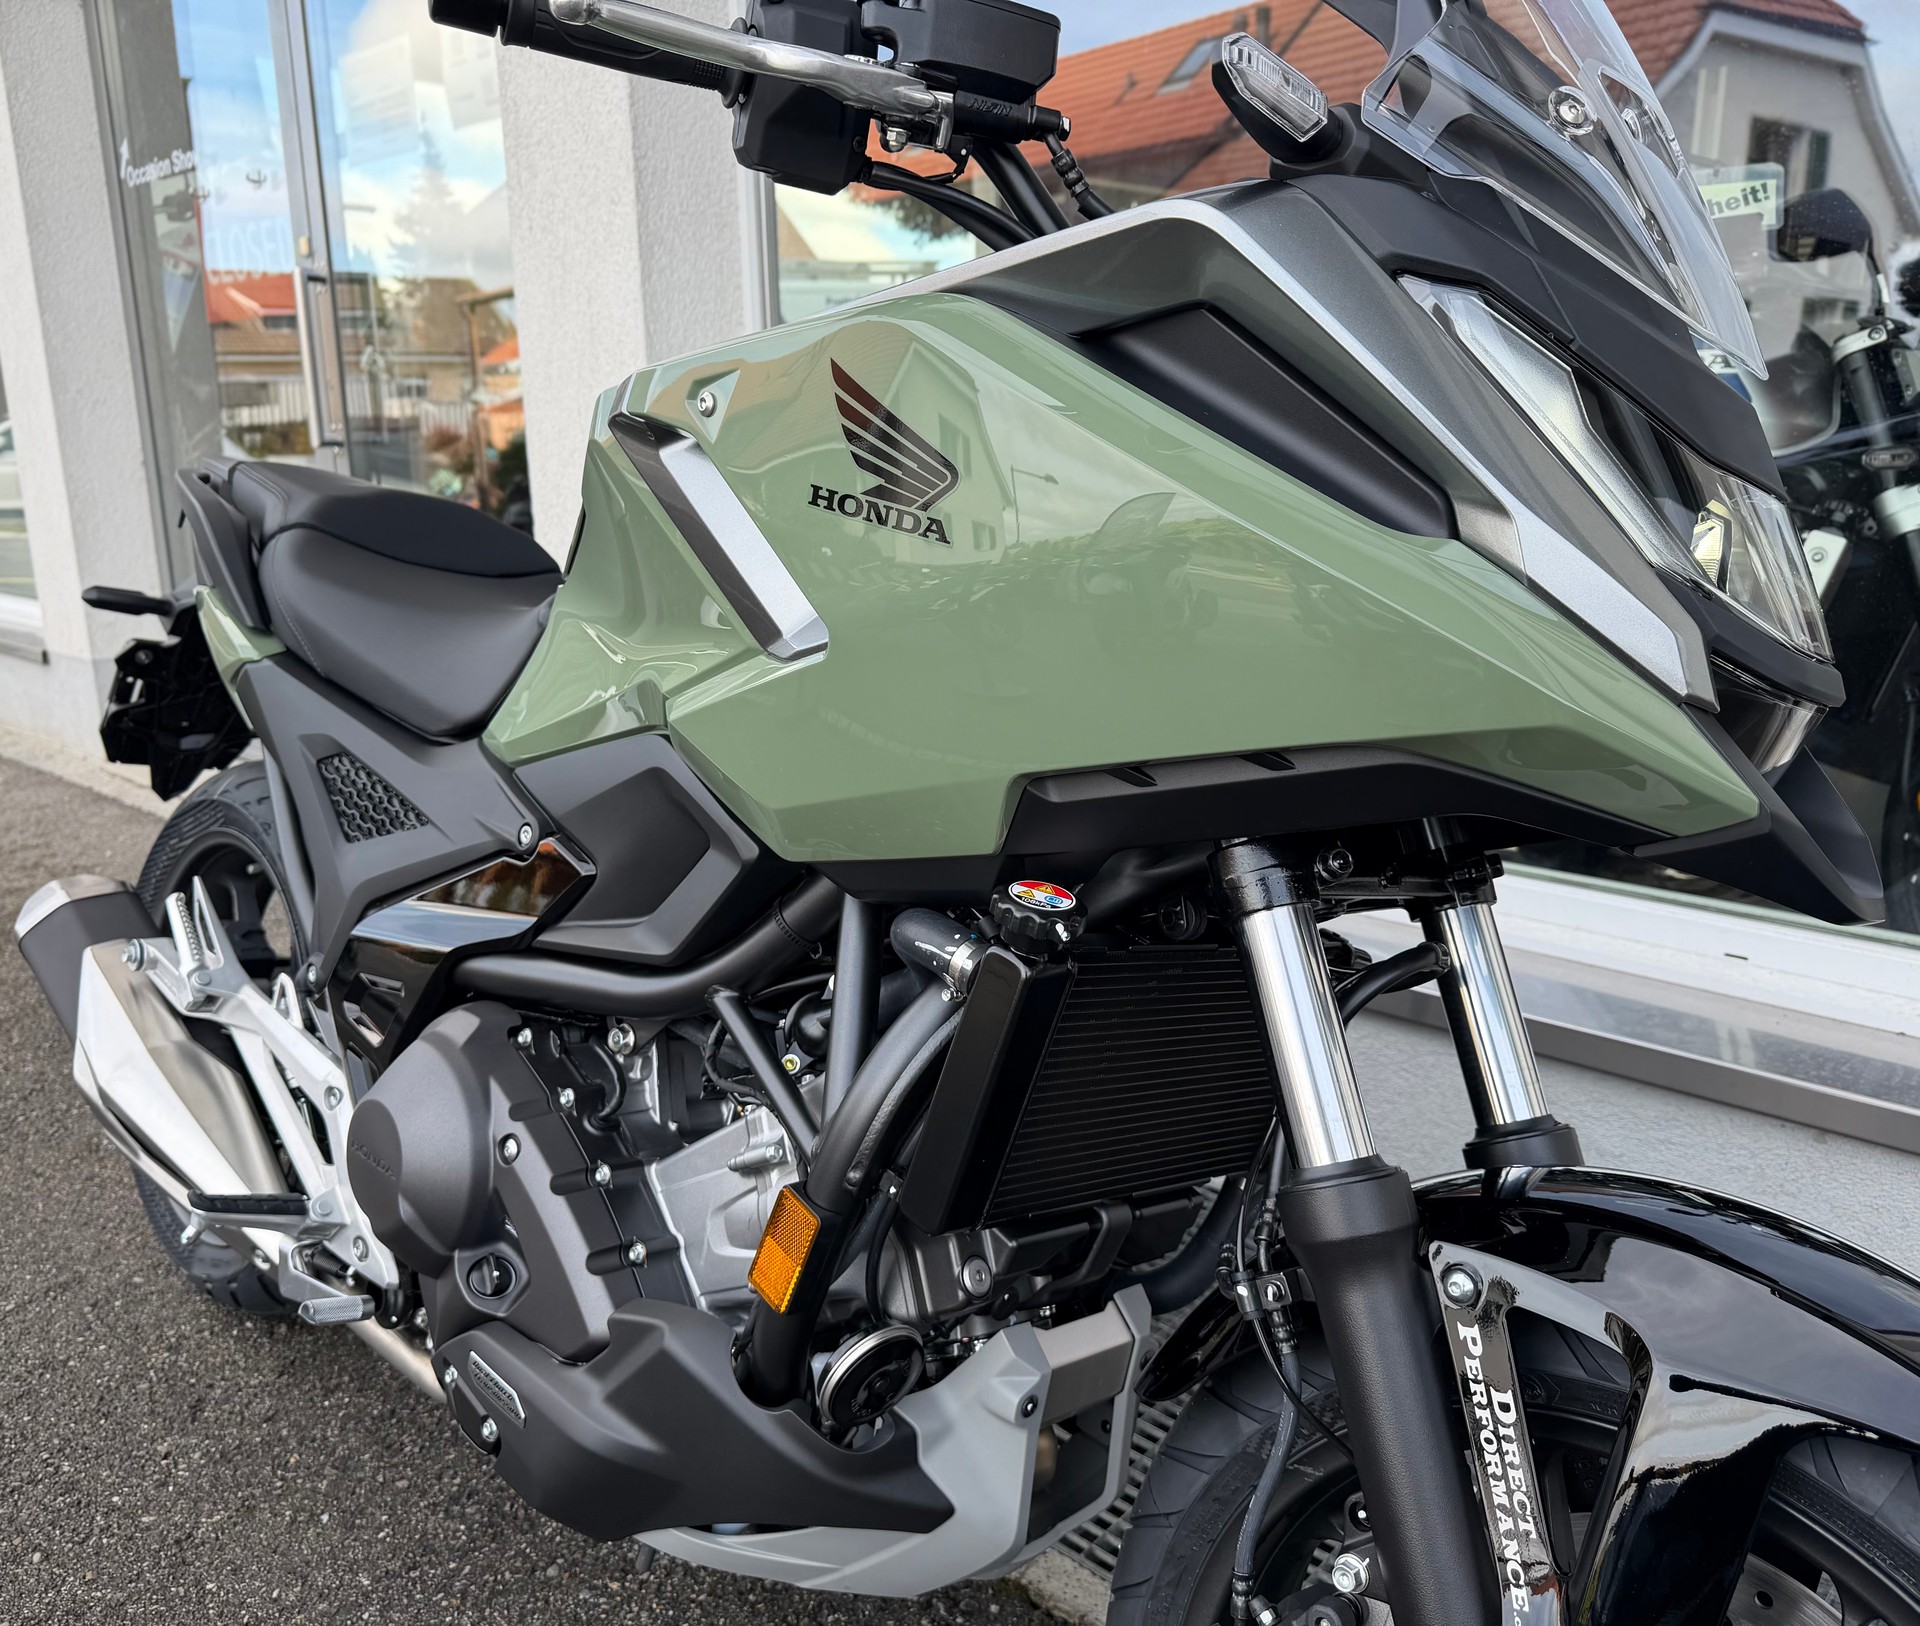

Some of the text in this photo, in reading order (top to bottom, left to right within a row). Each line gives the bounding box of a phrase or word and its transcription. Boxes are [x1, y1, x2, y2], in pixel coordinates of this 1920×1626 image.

[126, 156, 171, 188] Occasion
[808, 484, 951, 544] HONDA
[1489, 1386, 1537, 1539] DIRECT
